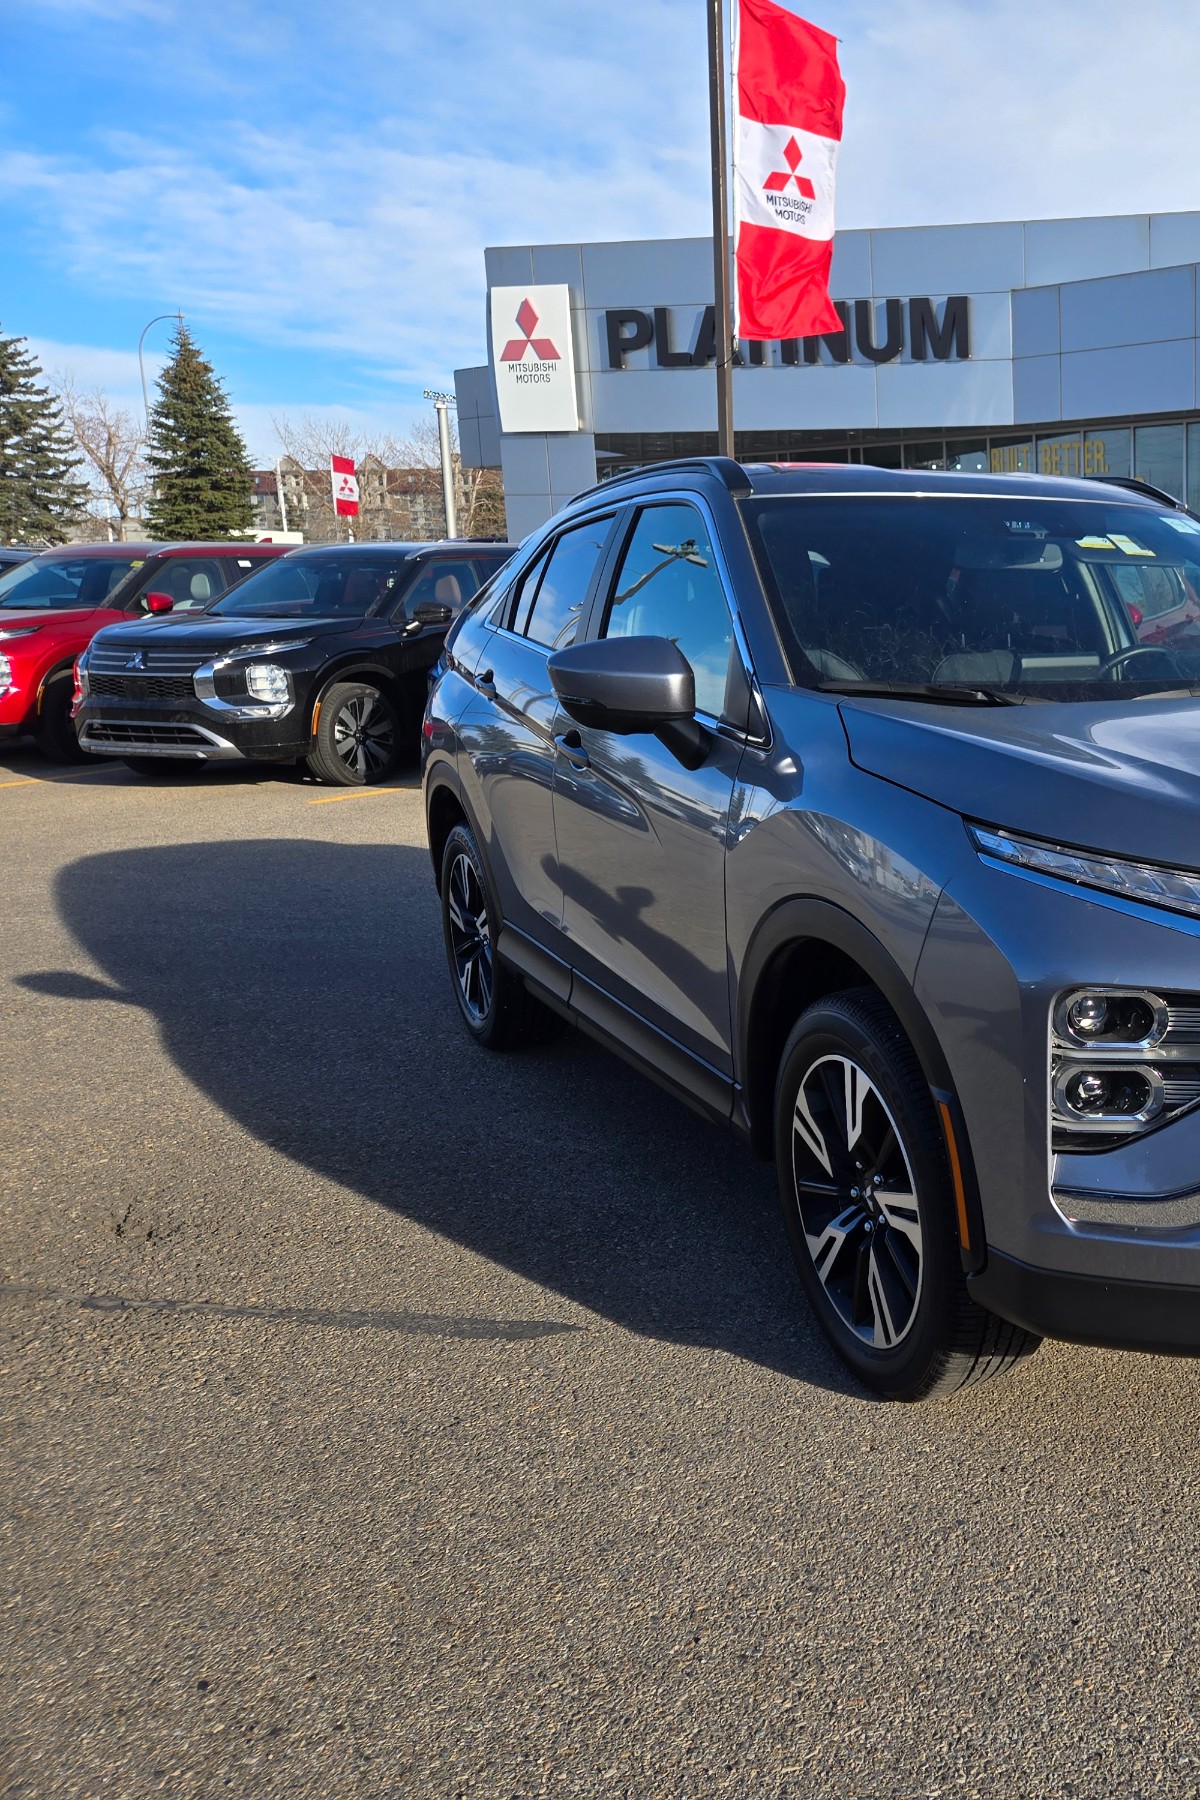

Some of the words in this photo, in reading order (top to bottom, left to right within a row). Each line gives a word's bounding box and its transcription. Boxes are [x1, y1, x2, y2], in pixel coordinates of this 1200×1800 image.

[766, 194, 813, 215] MITSUBISHI
[774, 208, 806, 225] MOTORS
[508, 362, 557, 373] MITSUBISHI
[516, 374, 551, 384] MOTORS
